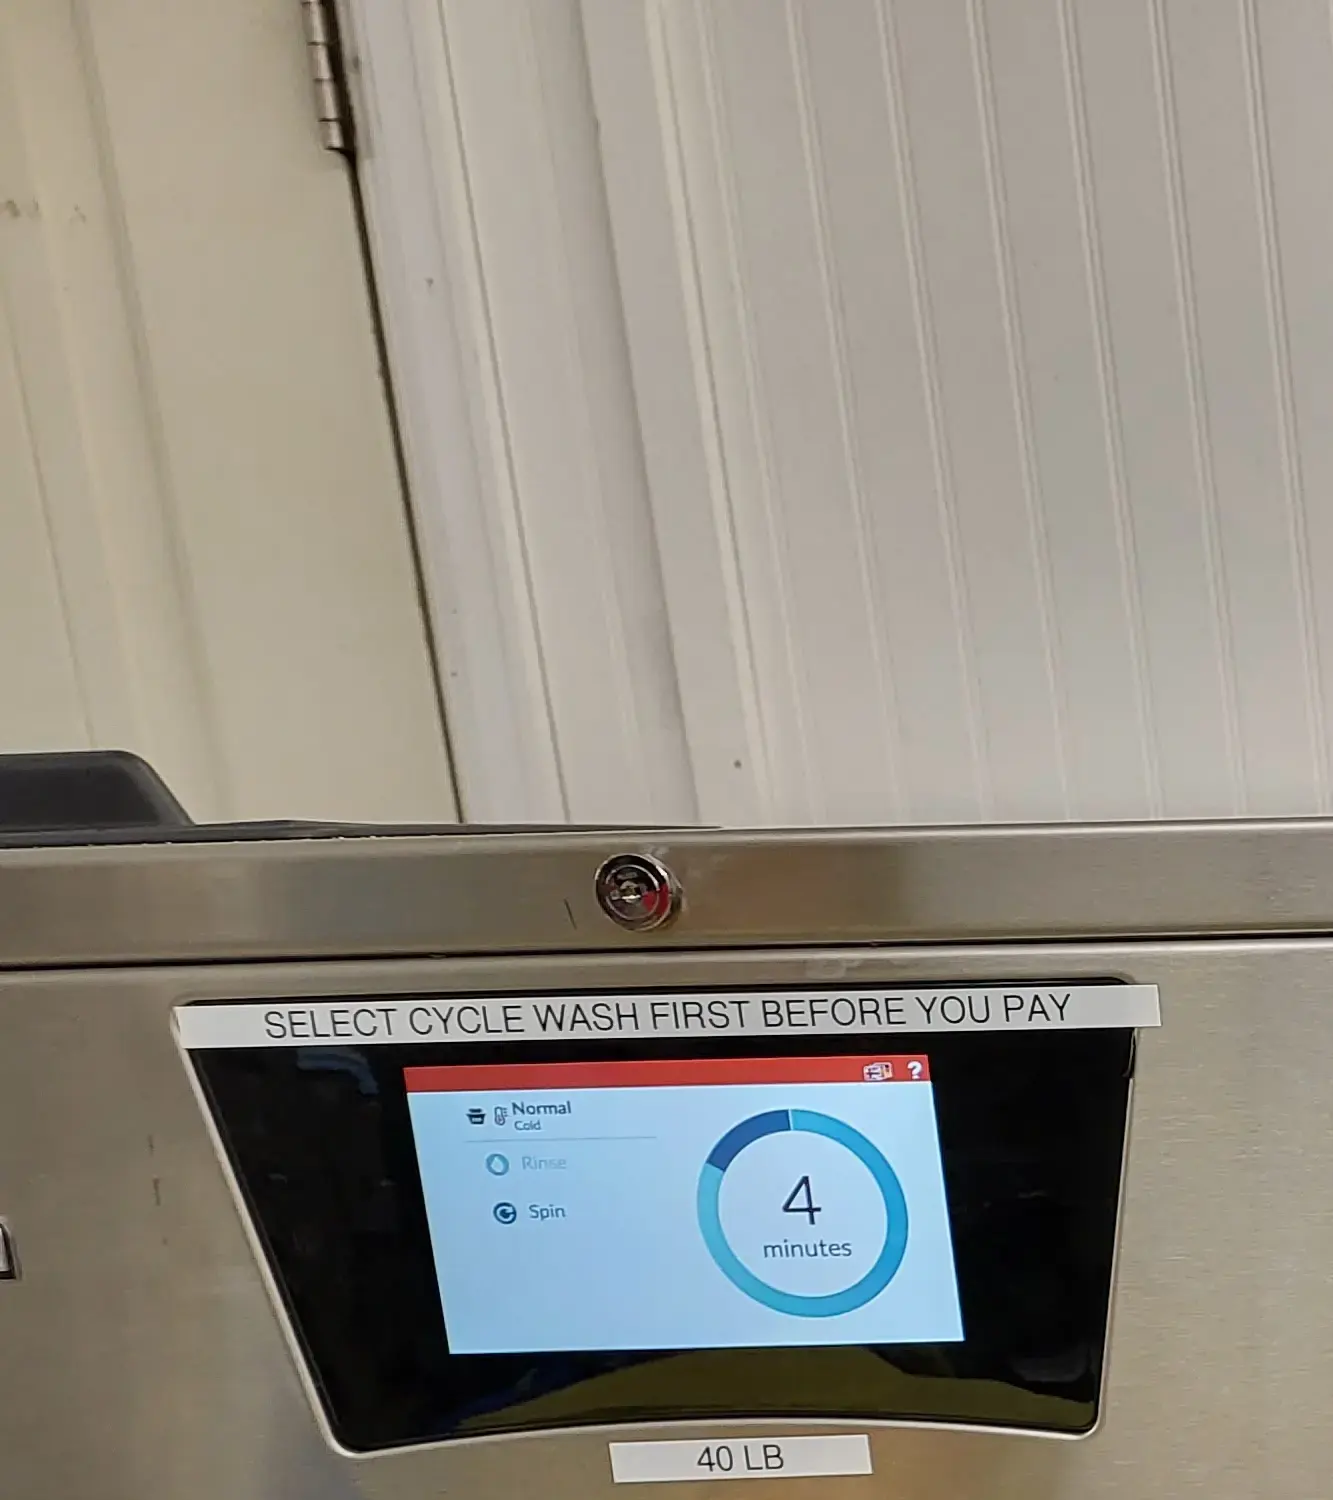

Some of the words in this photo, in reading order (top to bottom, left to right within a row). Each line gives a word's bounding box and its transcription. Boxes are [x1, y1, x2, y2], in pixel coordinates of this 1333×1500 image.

[264, 1010, 399, 1038] SELECT
[409, 1006, 524, 1036] CYCLE
[532, 1003, 640, 1033] WASH
[650, 1000, 750, 1030] FIRST
[762, 996, 906, 1027] BEFORE
[914, 994, 995, 1025] YOU
[1004, 992, 1071, 1022] PAY
[512, 1101, 571, 1115] Normal
[514, 1120, 541, 1131] Cold
[522, 1156, 567, 1170] Rinse
[781, 1175, 822, 1226] 4
[529, 1204, 566, 1220] Spin
[763, 1236, 852, 1260] minutes
[697, 1446, 735, 1473] 40
[745, 1445, 785, 1471] LB
